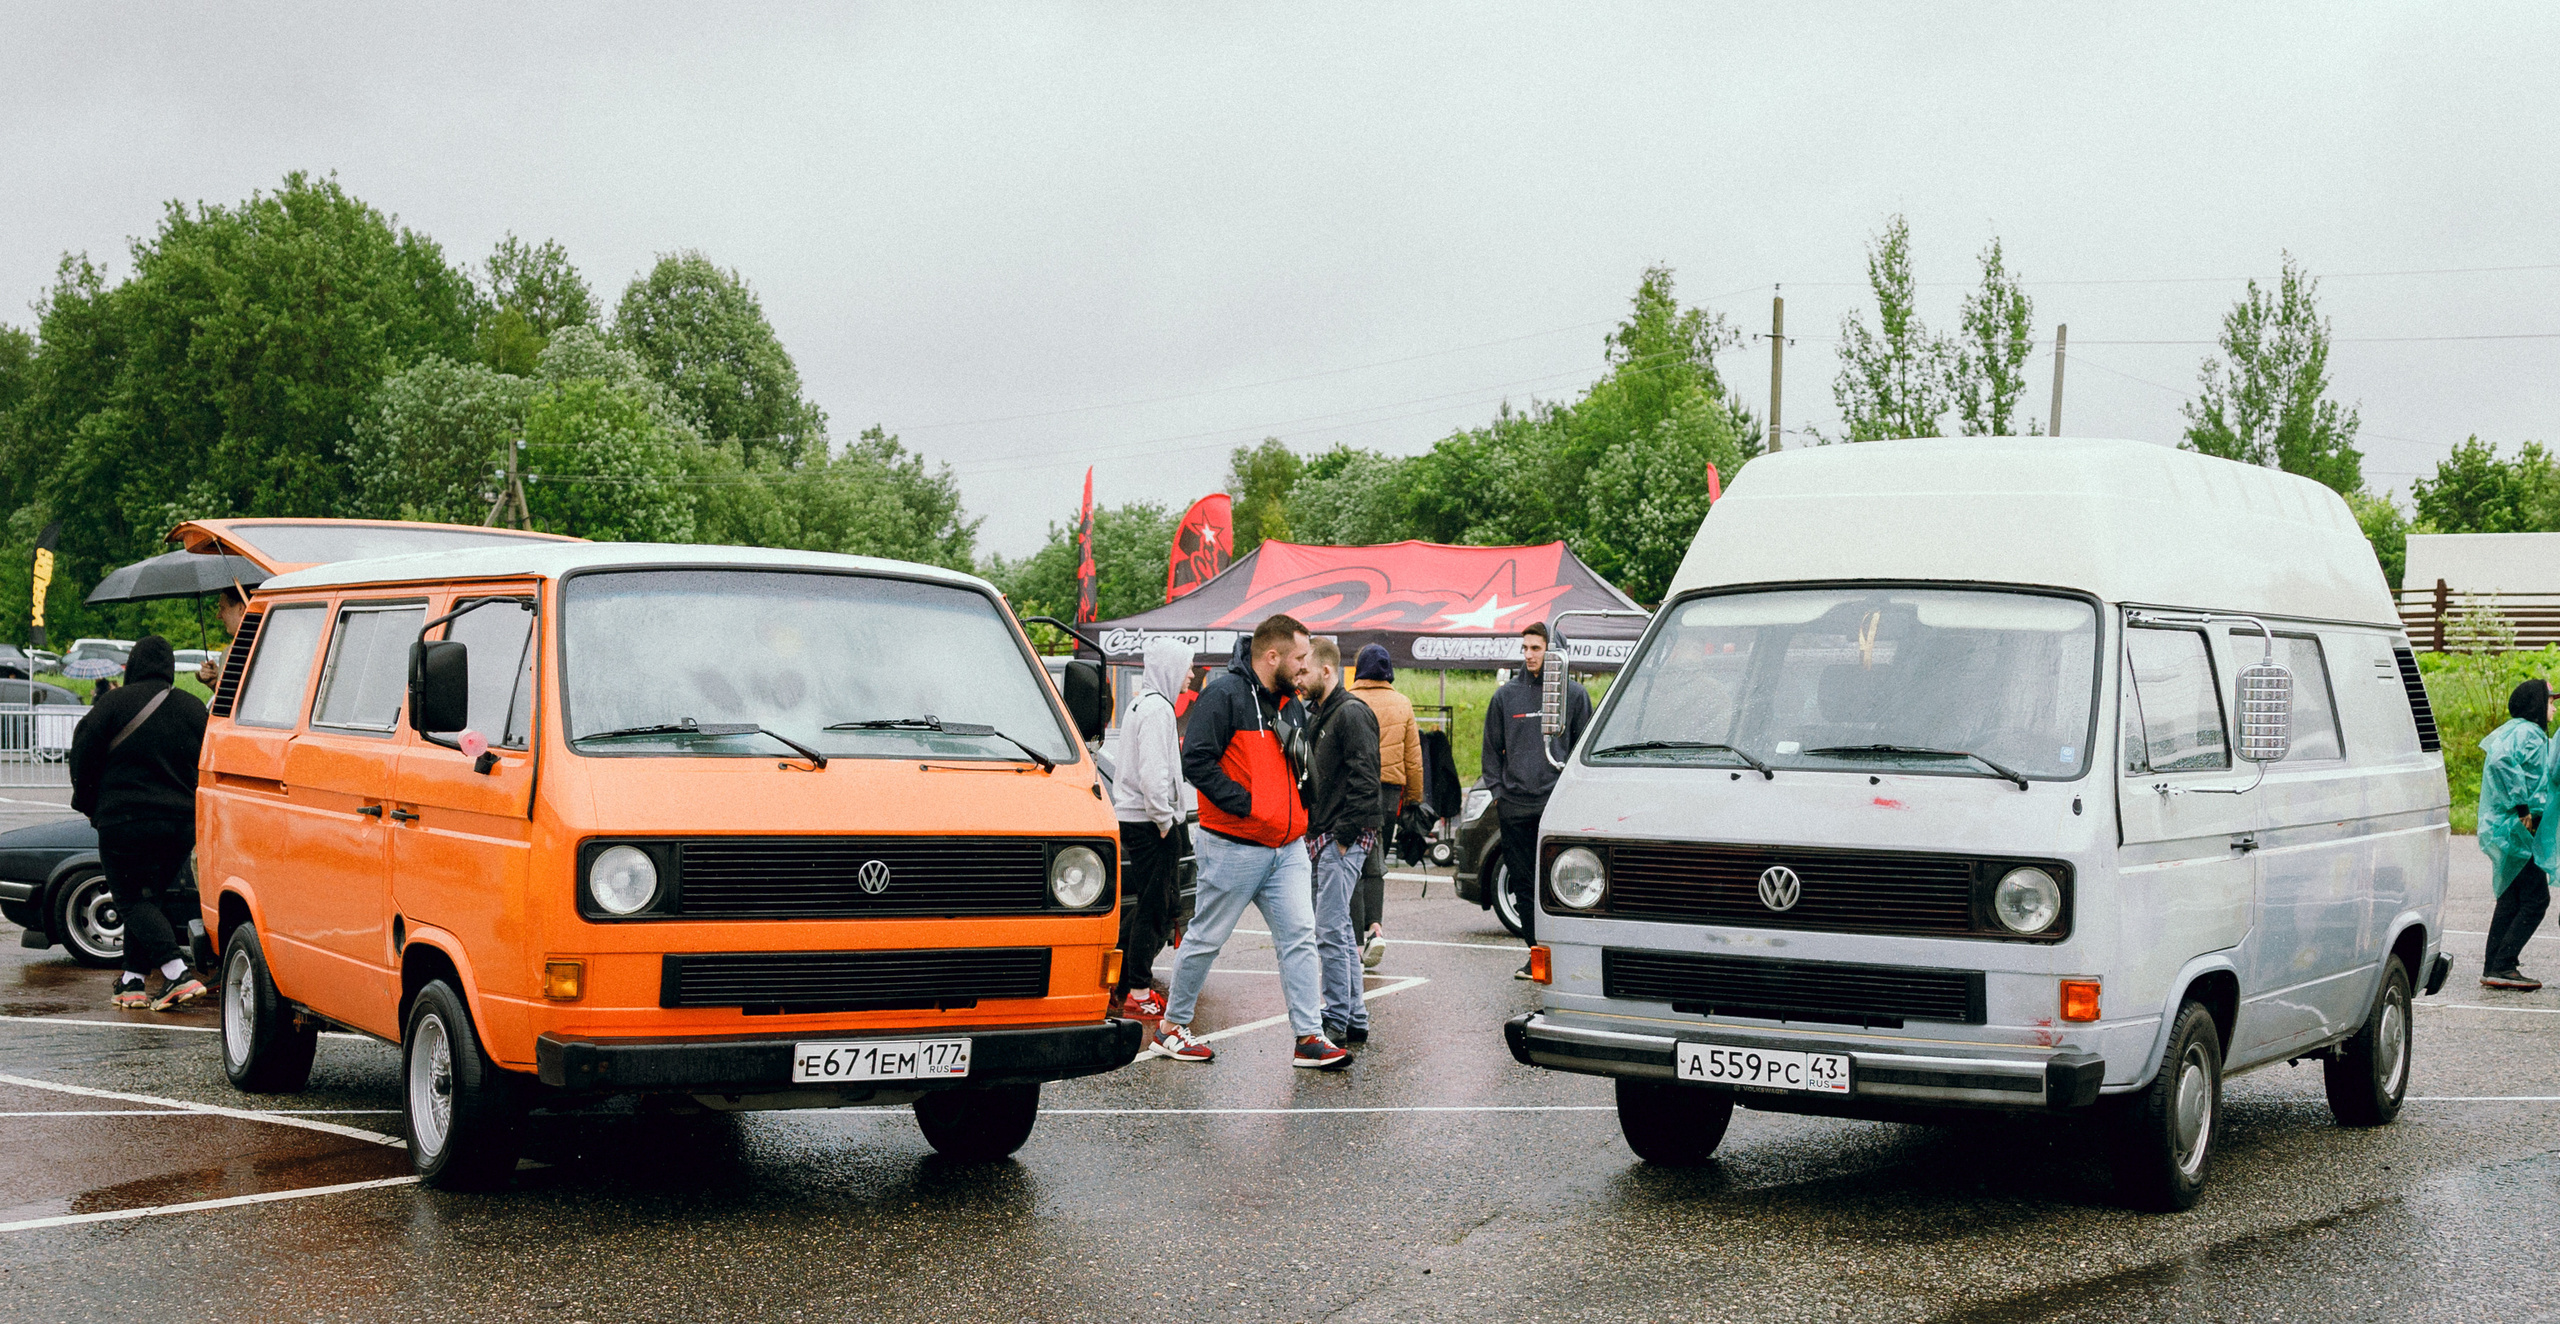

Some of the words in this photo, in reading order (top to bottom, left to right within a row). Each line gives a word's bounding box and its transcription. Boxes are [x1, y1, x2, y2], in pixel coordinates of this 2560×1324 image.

[923, 1043, 963, 1066] 177
[929, 1065, 950, 1073] RUS
[1811, 1057, 1838, 1079] 43
[1809, 1079, 1830, 1088] RUS
